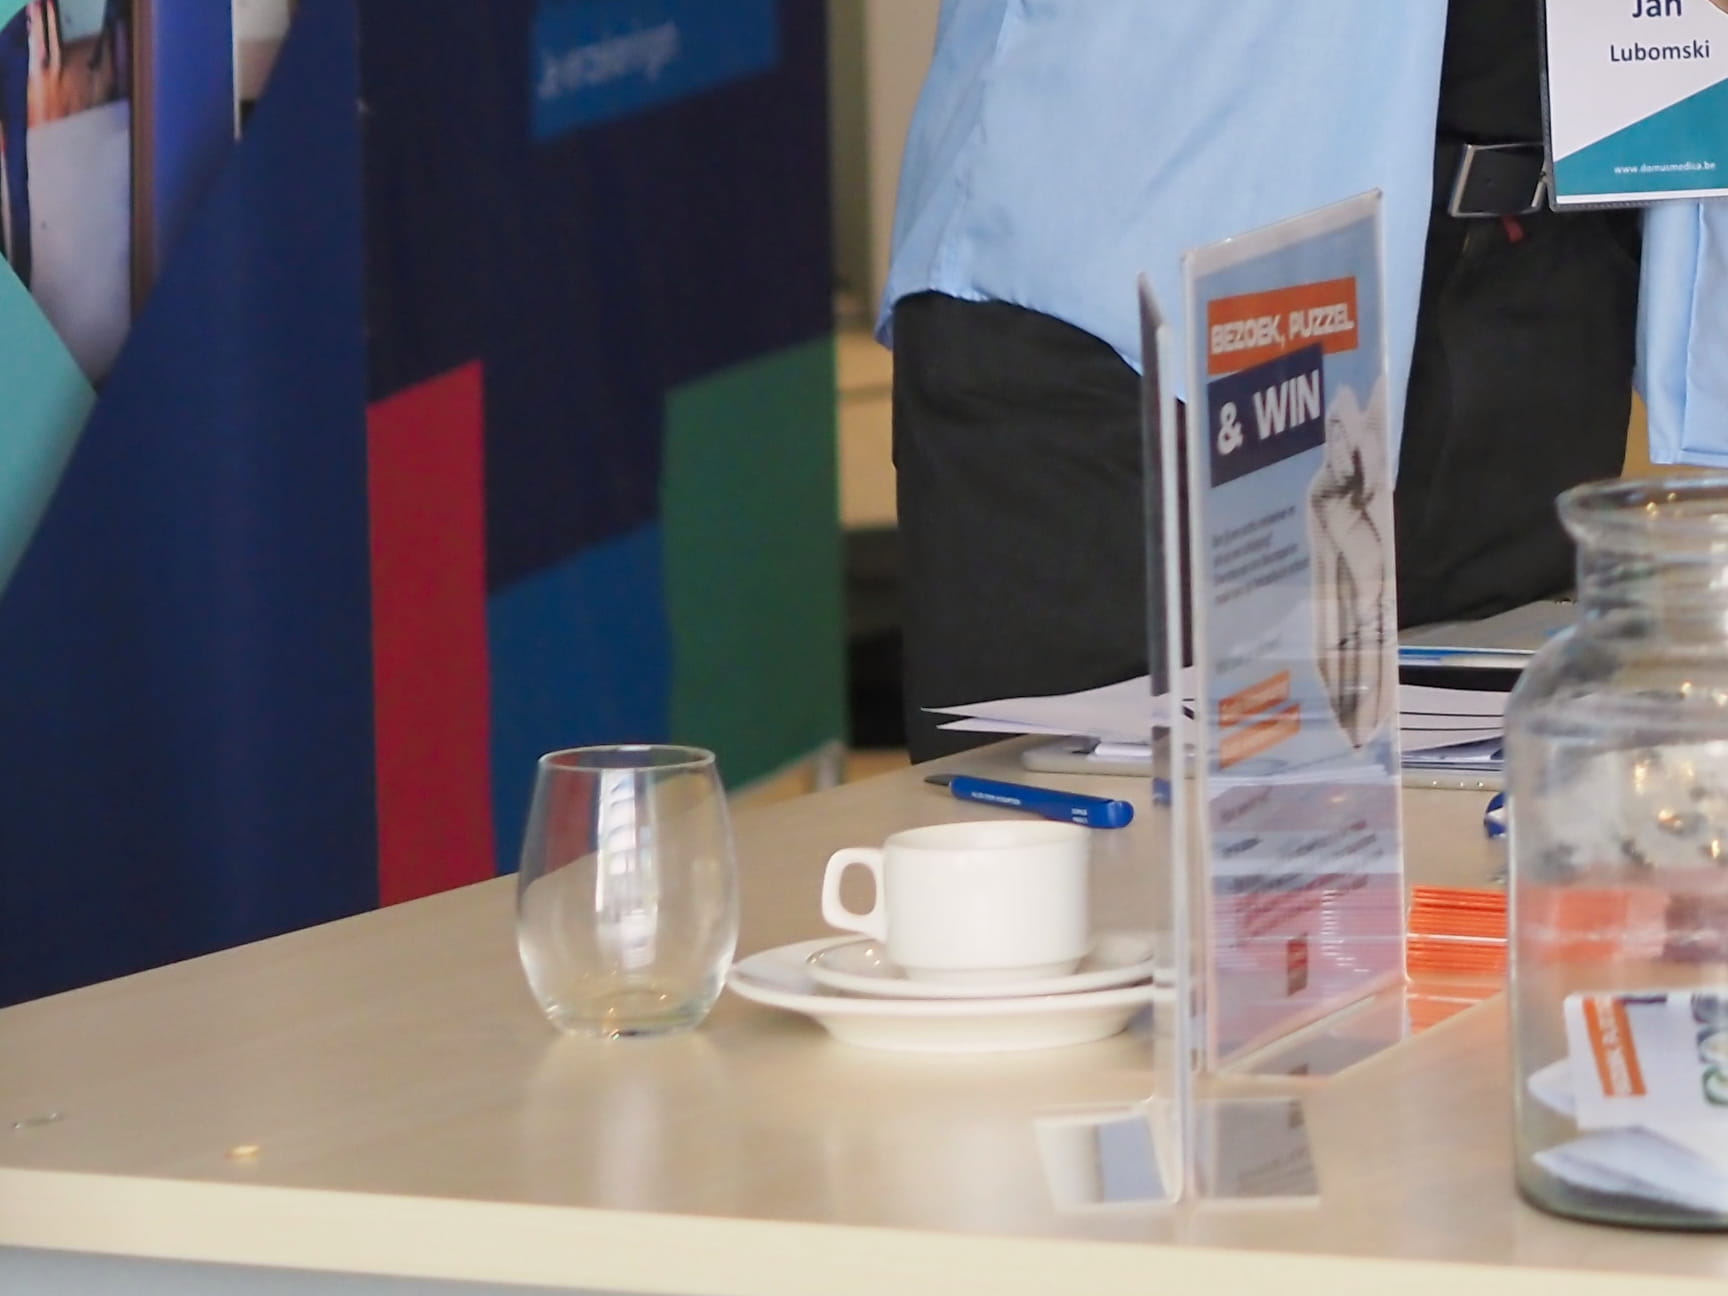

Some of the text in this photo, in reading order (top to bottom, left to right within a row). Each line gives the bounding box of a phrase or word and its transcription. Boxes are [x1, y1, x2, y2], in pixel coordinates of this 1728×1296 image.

[1609, 40, 1711, 63] Lubomski
[1613, 160, 1717, 175] www.domusmedica.be
[1210, 302, 1356, 351] BEZOEK, PUZZEL
[1216, 368, 1322, 456] & WIN
